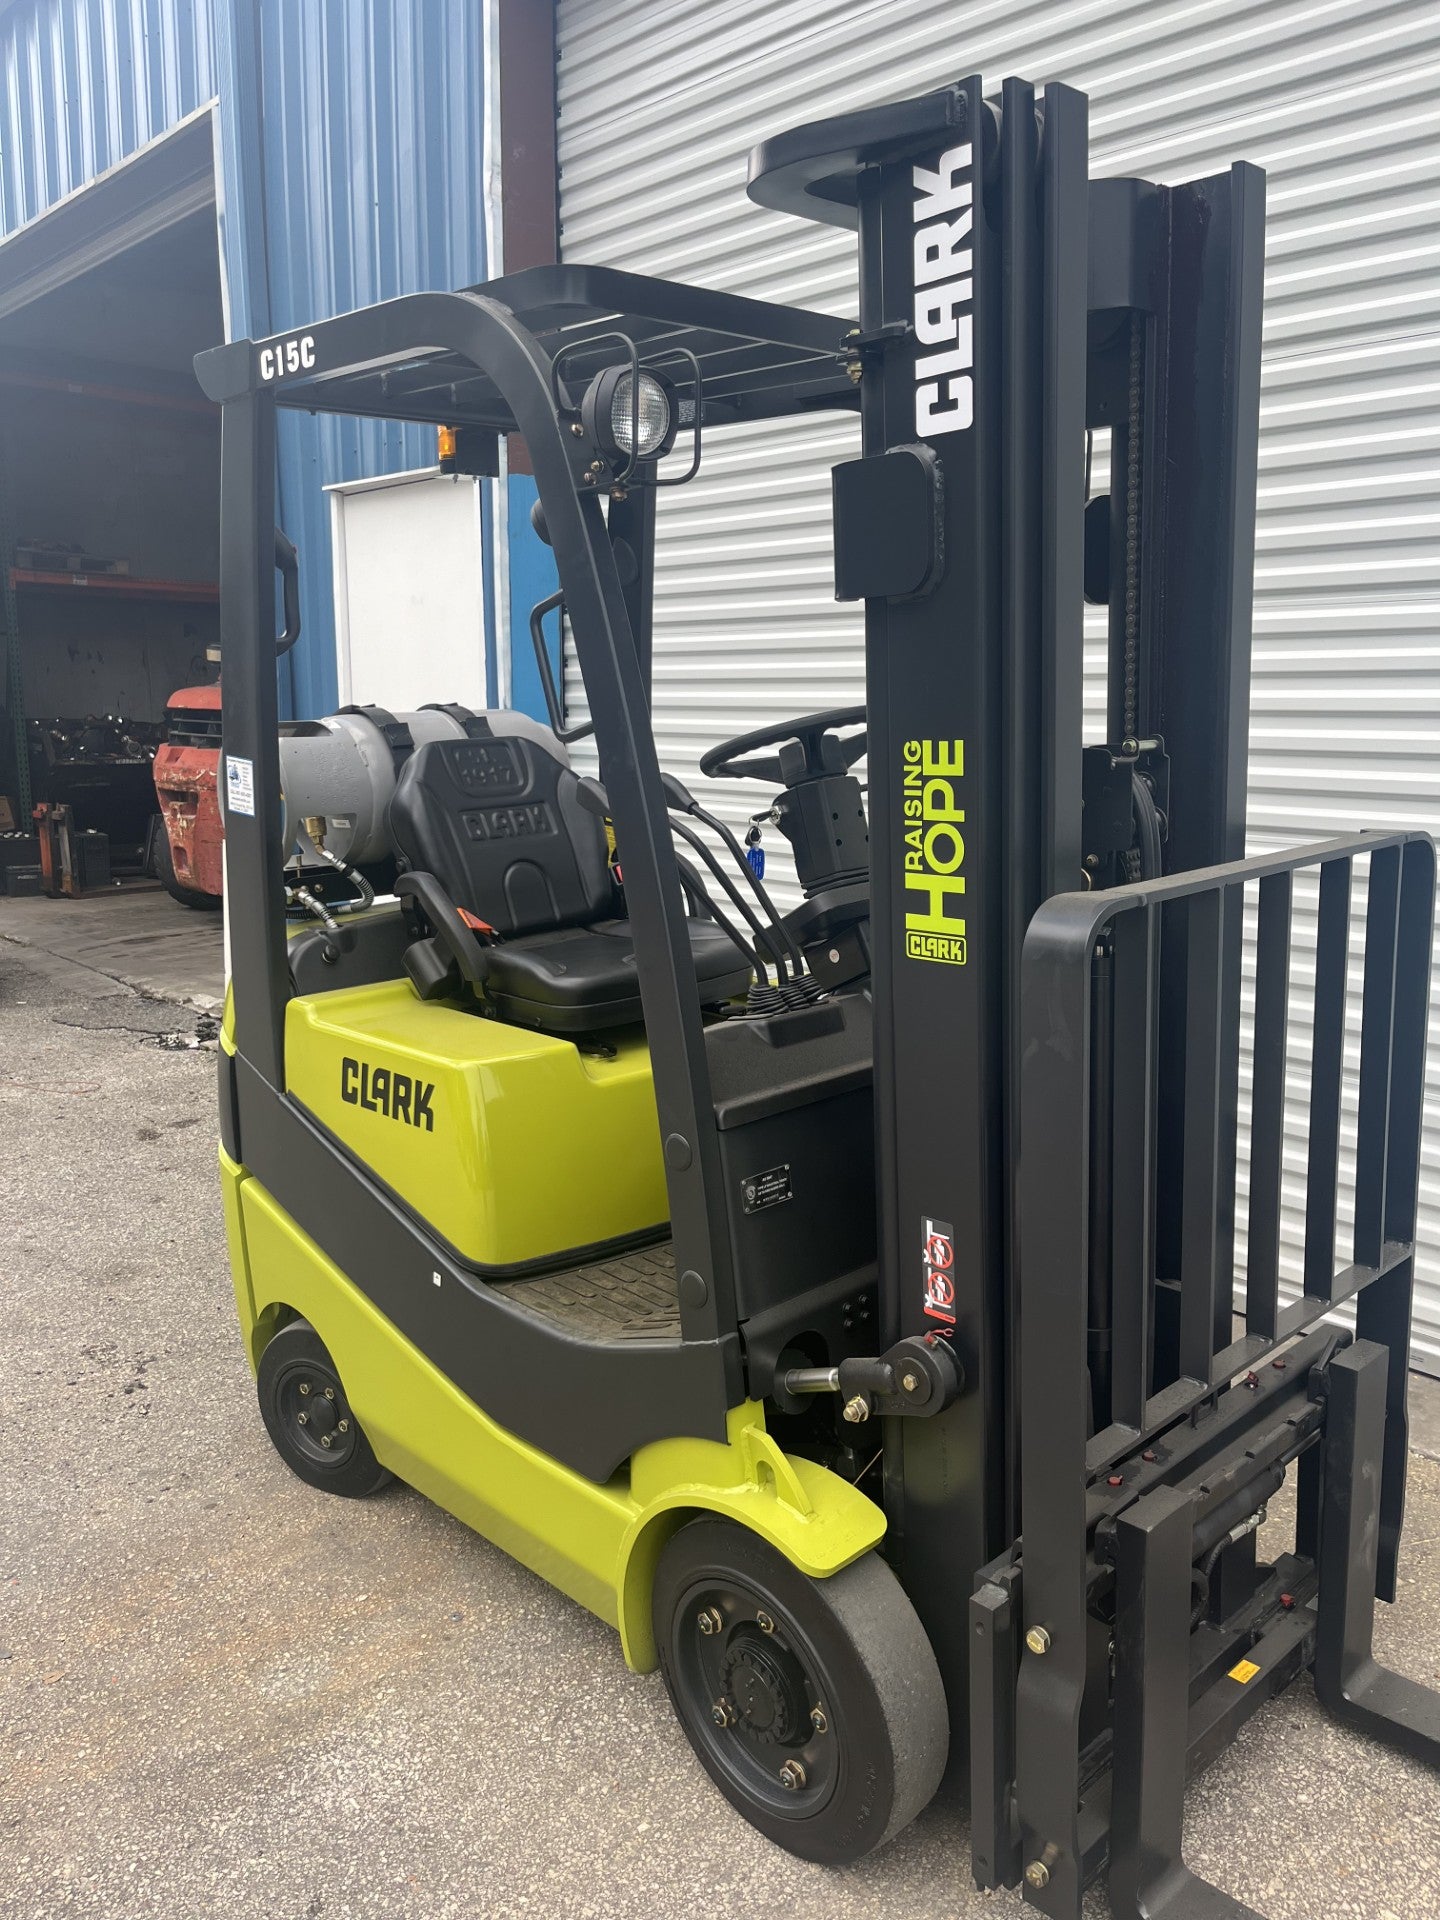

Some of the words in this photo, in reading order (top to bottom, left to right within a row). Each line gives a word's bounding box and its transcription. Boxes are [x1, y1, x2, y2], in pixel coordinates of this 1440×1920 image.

[913, 142, 973, 438] CLARK
[260, 335, 315, 381] C15C
[903, 740, 924, 871] RAISING
[904, 739, 965, 936] HOPE
[909, 935, 963, 961] CLARK
[341, 1056, 436, 1133] CLARK
